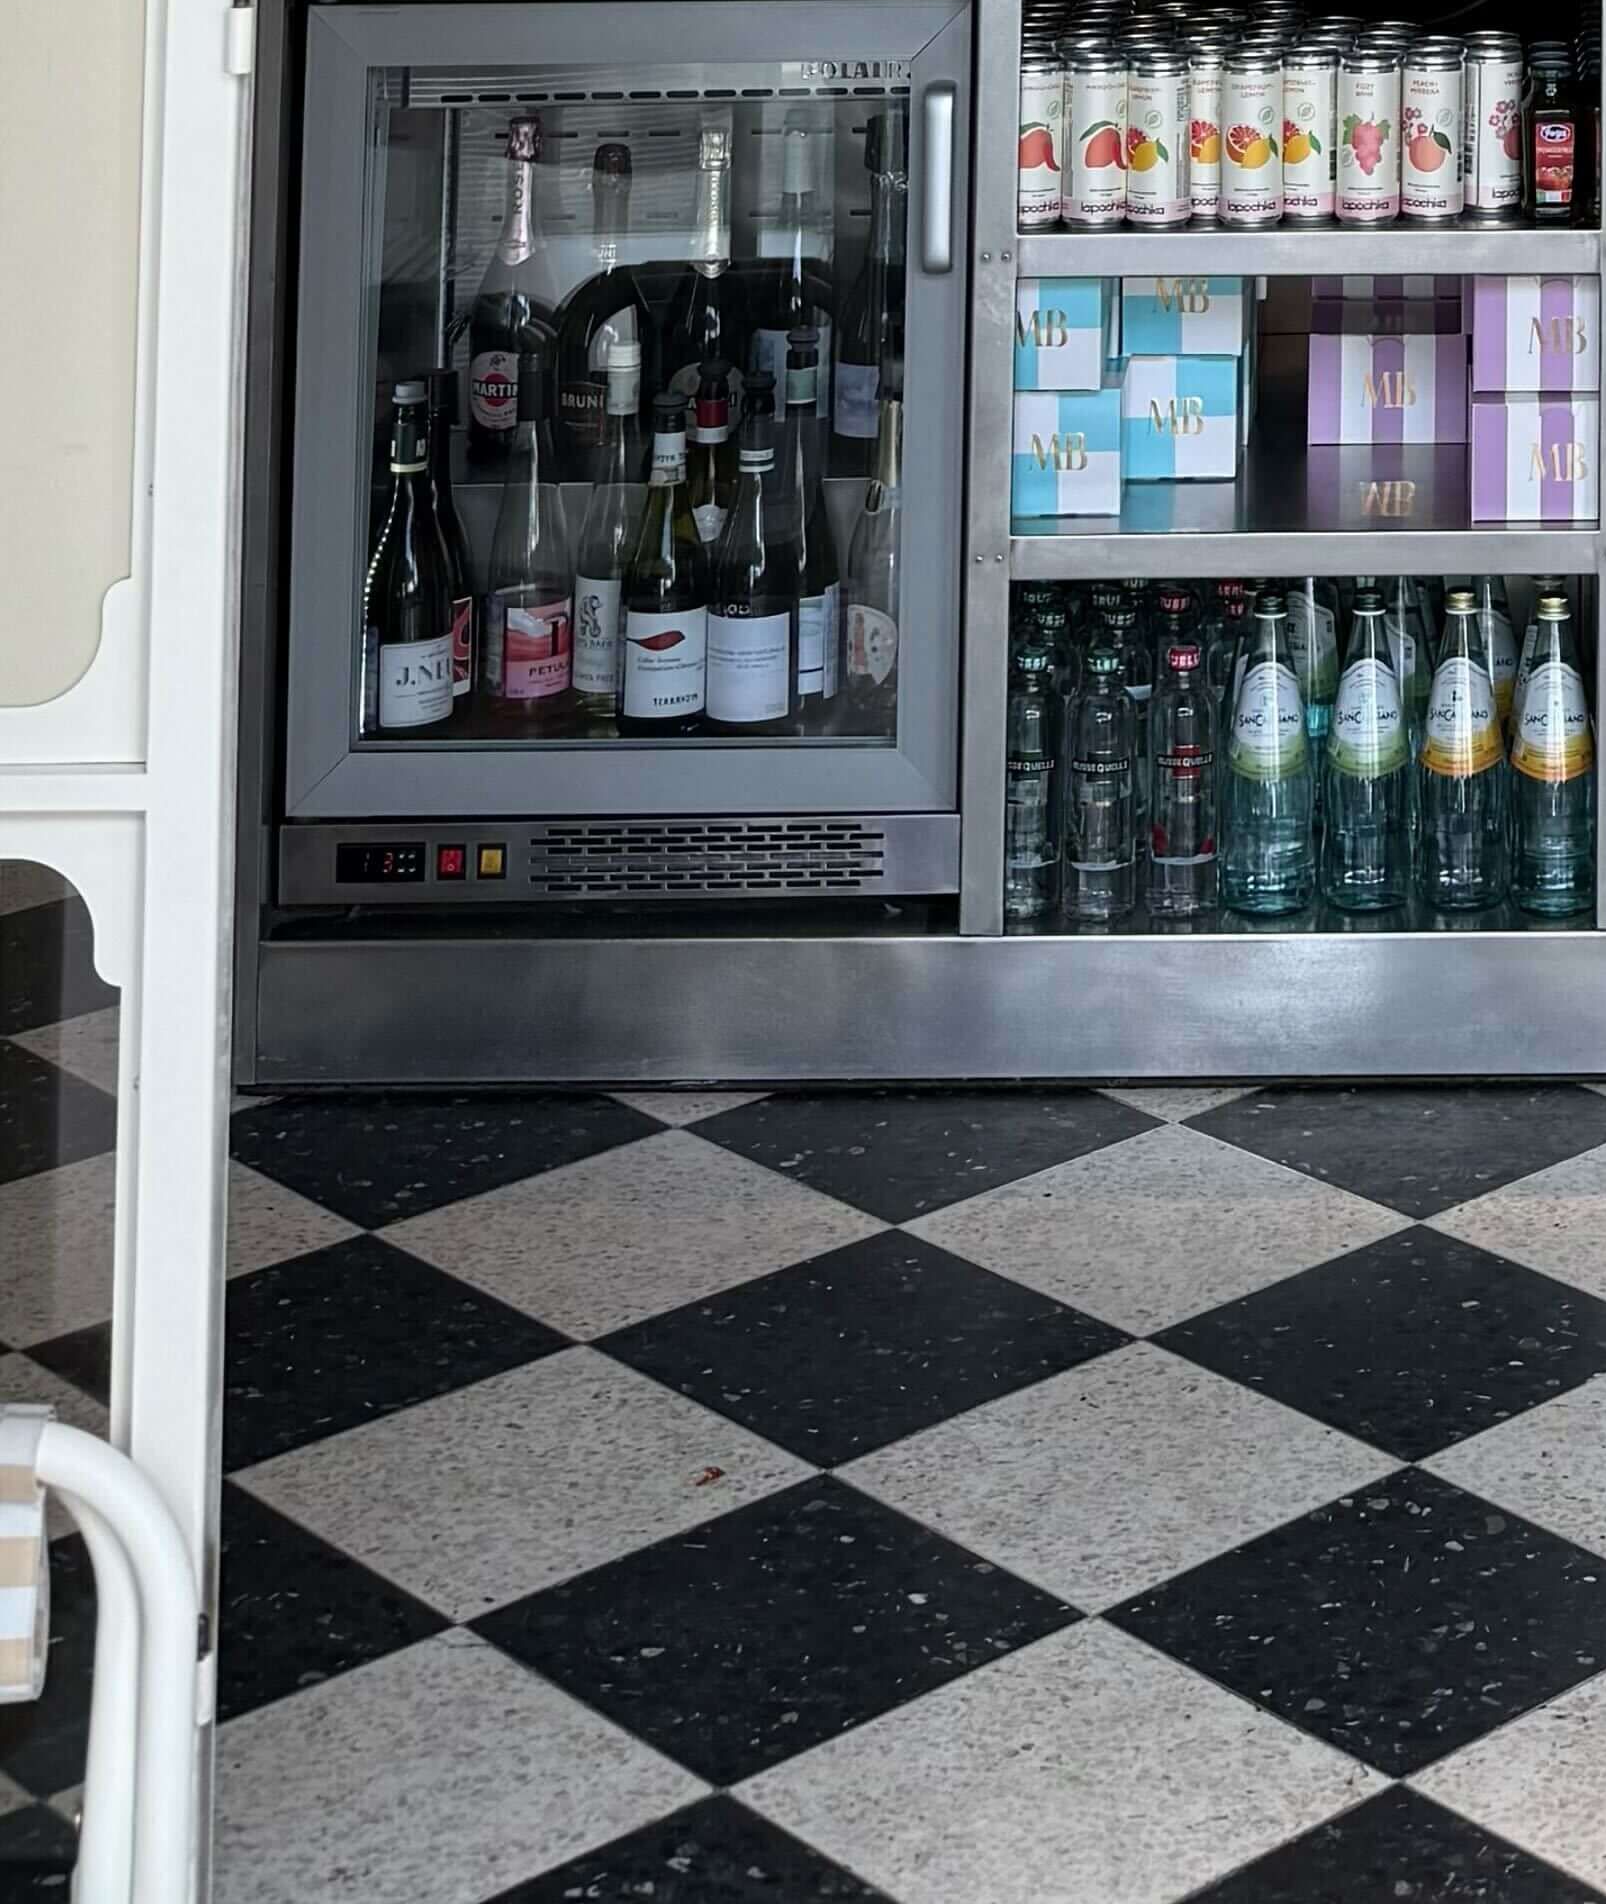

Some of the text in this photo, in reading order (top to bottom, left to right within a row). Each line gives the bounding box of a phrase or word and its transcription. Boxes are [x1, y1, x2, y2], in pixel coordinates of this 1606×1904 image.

[1153, 277, 1210, 313] MB
[1016, 308, 1068, 348] MB
[1528, 316, 1588, 355] MB
[1359, 370, 1417, 409] MB
[1147, 395, 1205, 436] MB
[1028, 431, 1088, 471] MB
[1528, 442, 1589, 482] MB
